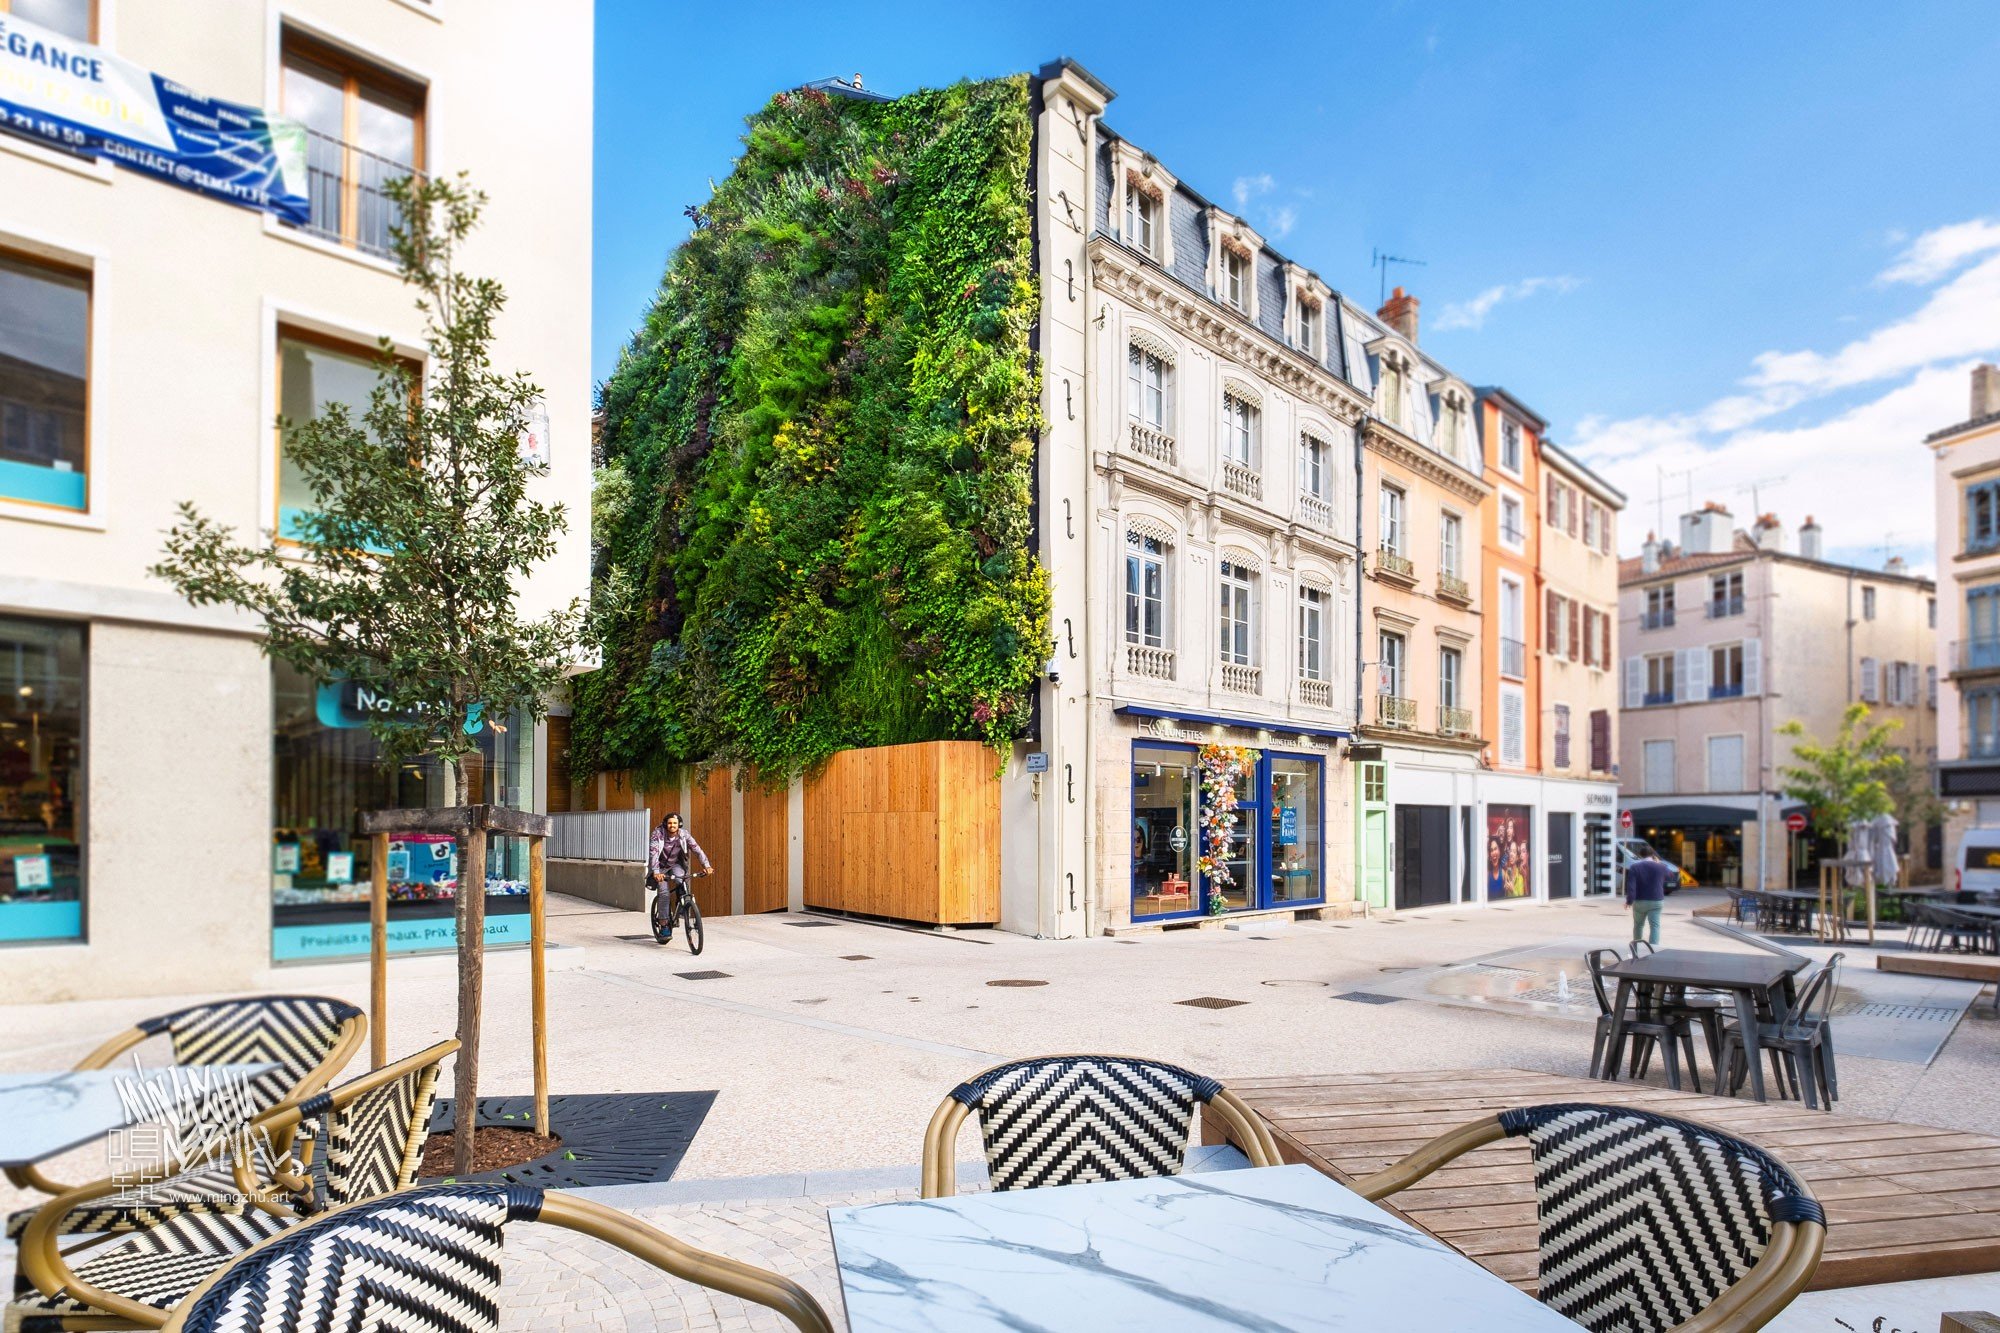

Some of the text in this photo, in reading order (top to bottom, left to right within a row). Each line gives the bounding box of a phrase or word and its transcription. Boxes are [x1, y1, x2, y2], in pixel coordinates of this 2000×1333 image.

[1586, 793, 1612, 805] SEPHORA
[361, 930, 422, 943] nmaux.
[424, 926, 447, 940] prix
